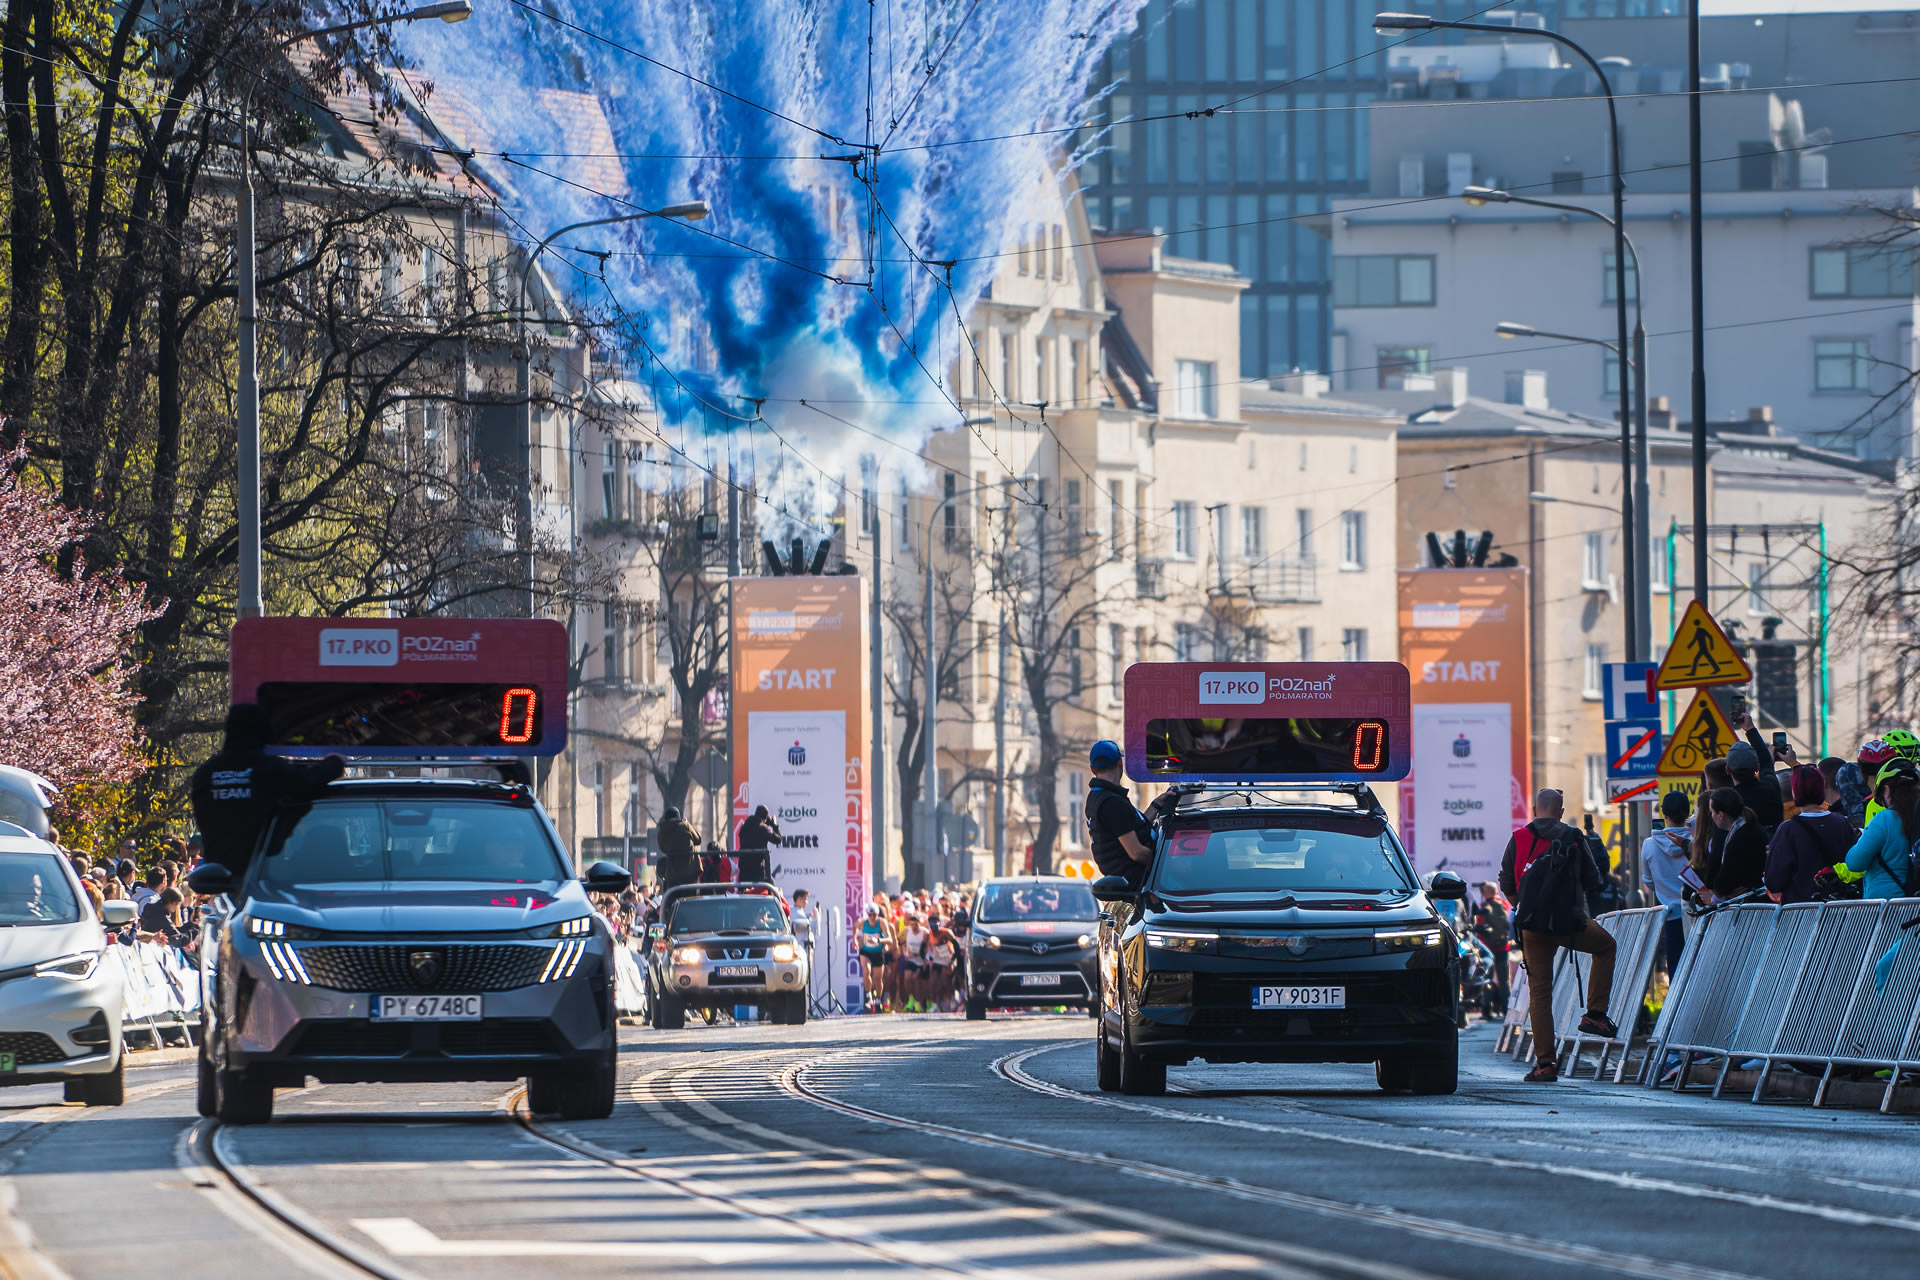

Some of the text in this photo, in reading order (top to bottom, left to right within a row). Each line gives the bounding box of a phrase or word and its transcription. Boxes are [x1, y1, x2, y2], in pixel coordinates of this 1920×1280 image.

[758, 668, 836, 691] START
[1422, 661, 1501, 683] START
[1269, 692, 1332, 700] PÓŁMARATON
[500, 688, 537, 742] 0
[1353, 722, 1383, 769] 0
[211, 788, 252, 800] TEAM
[778, 805, 817, 818] żabka
[1263, 988, 1341, 1004] PY 9031F
[383, 997, 478, 1016] PY 6748C
